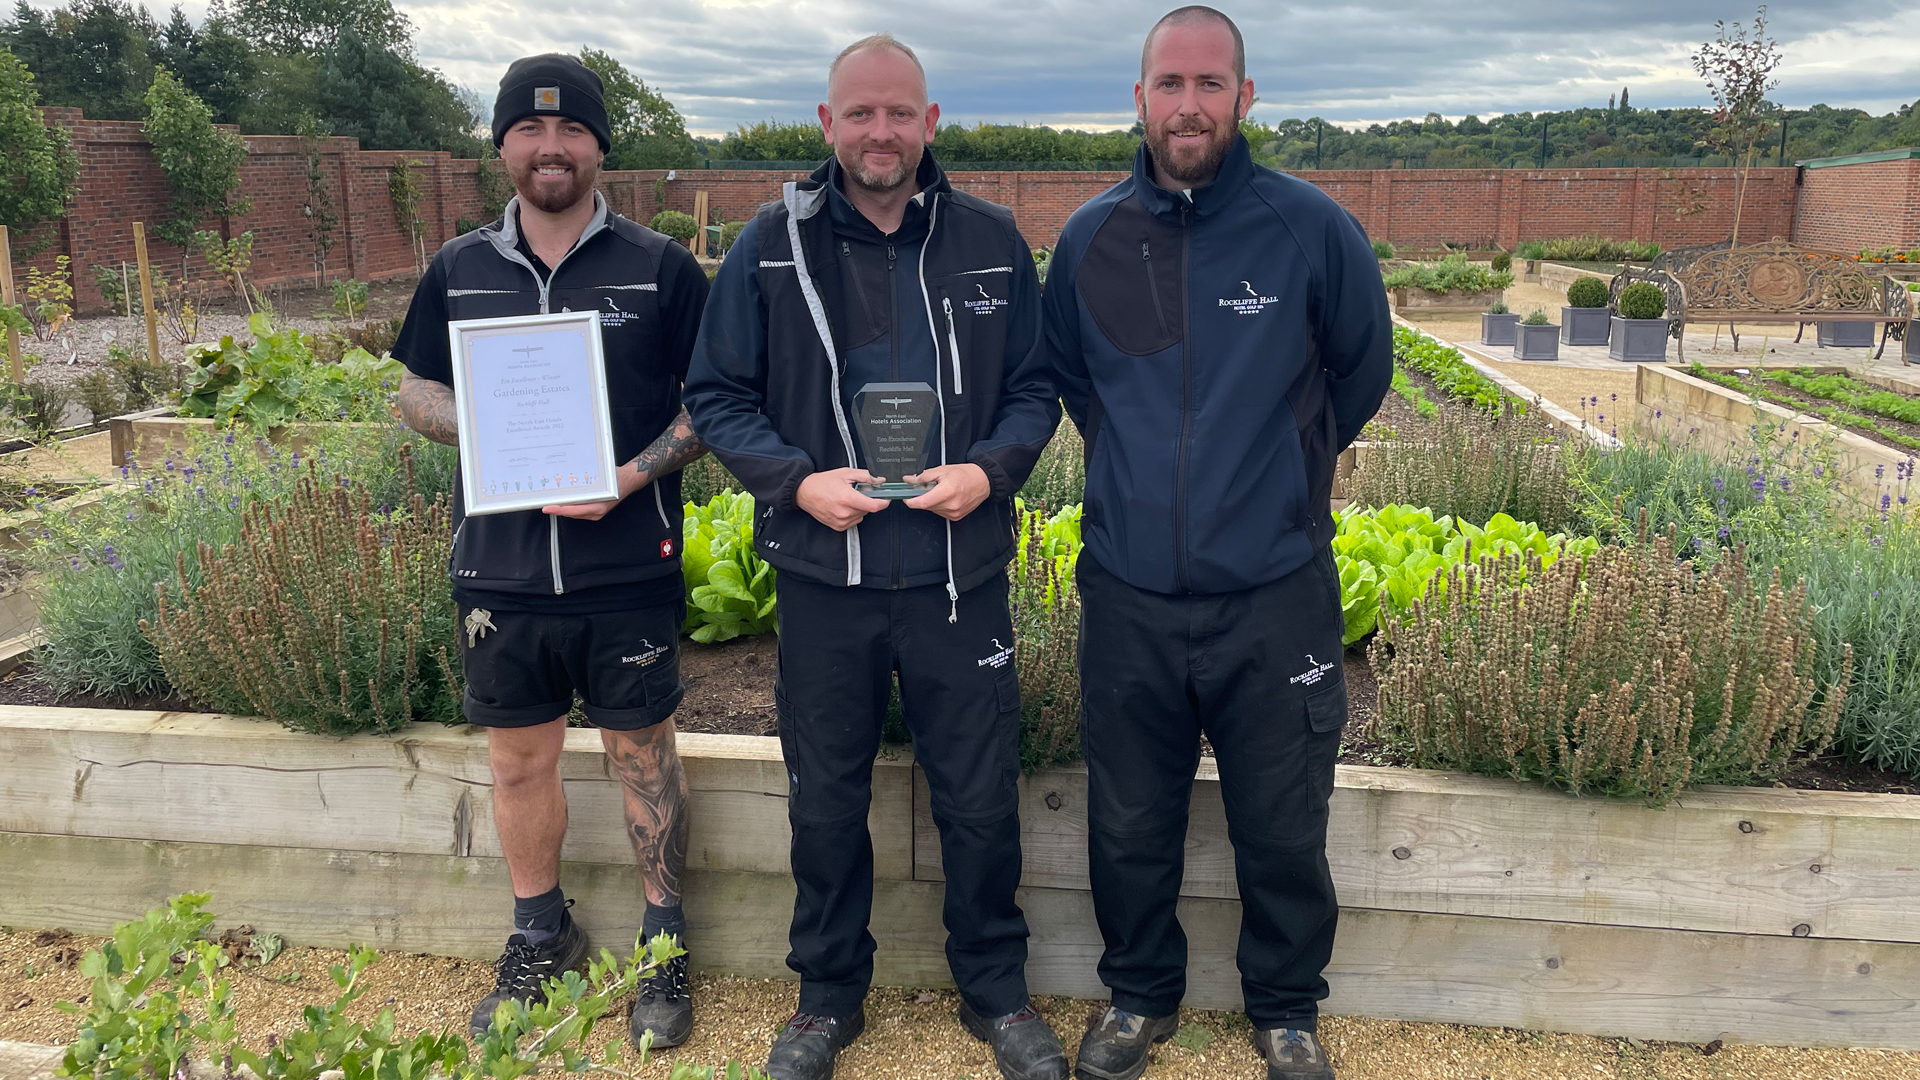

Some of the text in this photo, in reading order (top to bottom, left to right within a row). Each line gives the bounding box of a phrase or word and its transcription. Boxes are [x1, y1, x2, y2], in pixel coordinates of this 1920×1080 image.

[1218, 296, 1279, 306] ROCKLIFFE HALL
[621, 311, 640, 319] HALL
[511, 376, 537, 384] Excellence
[493, 385, 570, 398] Gardening Estates
[506, 425, 532, 434] Excellence
[621, 650, 655, 663] ROCKLIFFE
[1290, 668, 1319, 684] ROCKLIFFE
[1320, 662, 1334, 671] HALL
